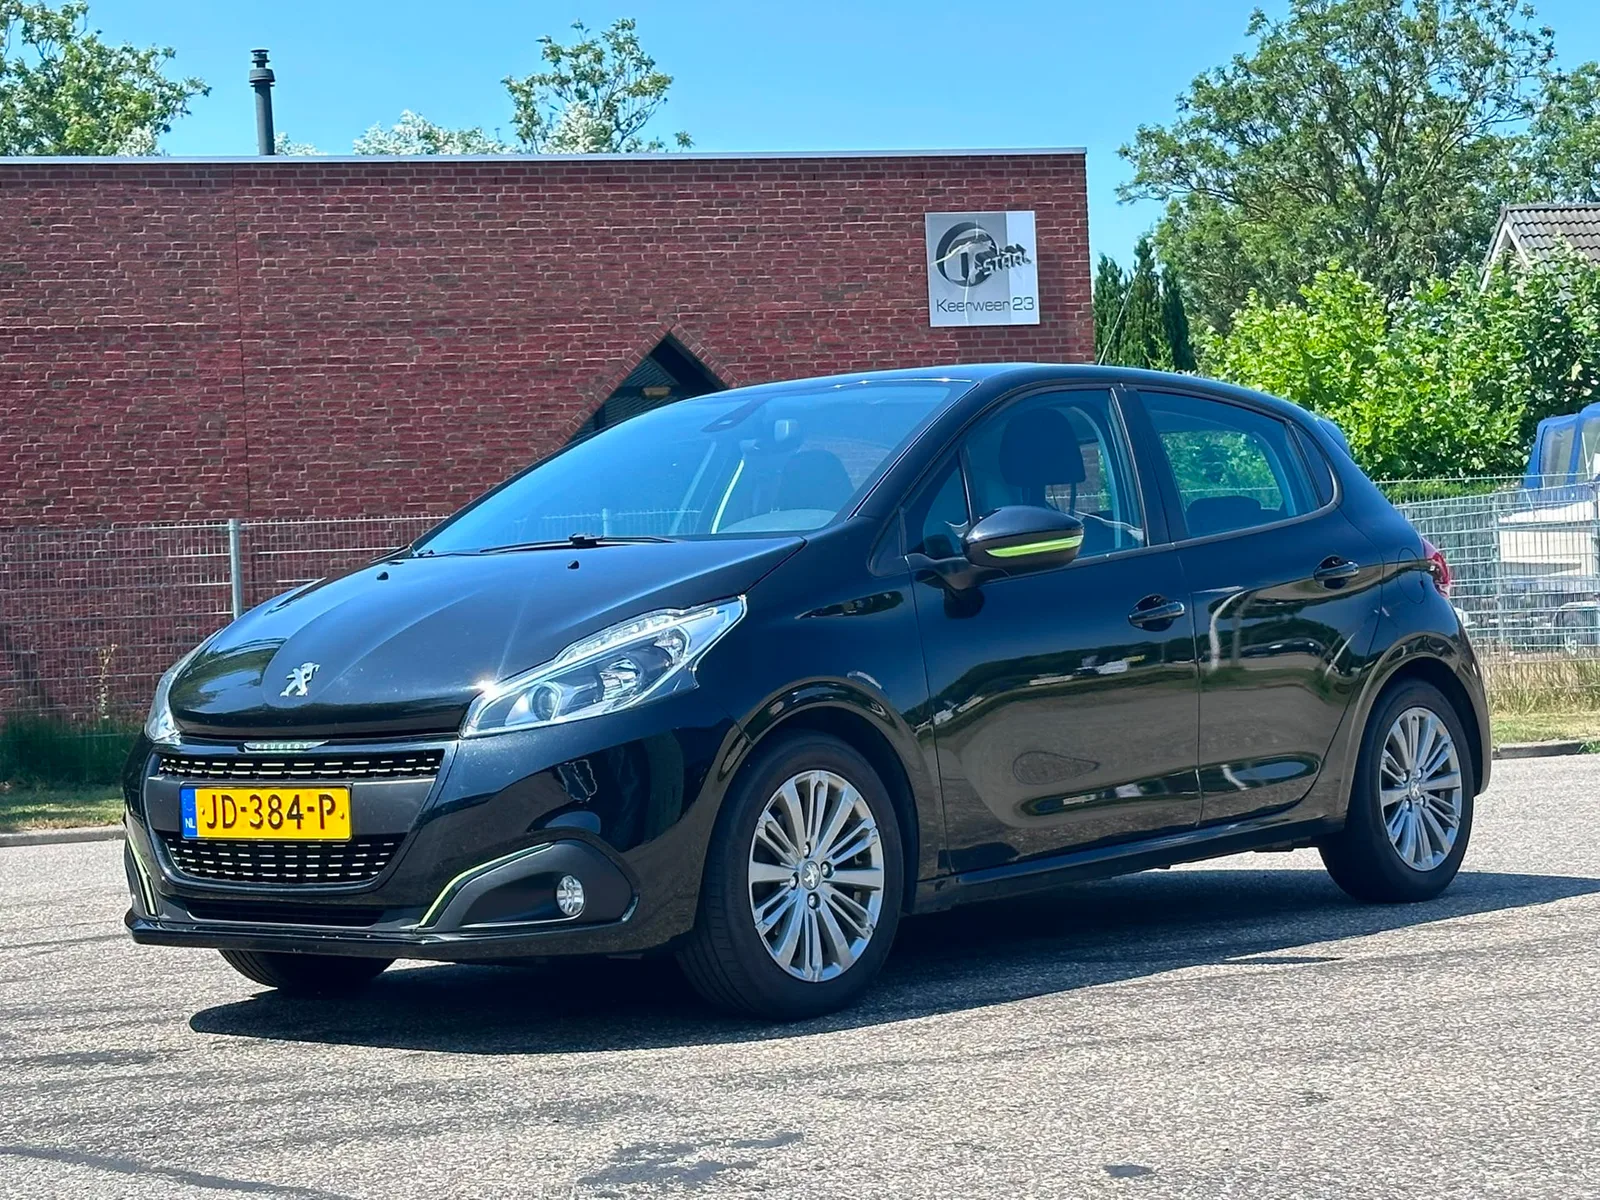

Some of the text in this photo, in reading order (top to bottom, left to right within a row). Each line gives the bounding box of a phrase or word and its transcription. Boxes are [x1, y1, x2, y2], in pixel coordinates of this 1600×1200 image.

[936, 297, 1034, 312] Keerweer 23
[206, 794, 336, 830] JD-384-P
[185, 818, 196, 828] NL
